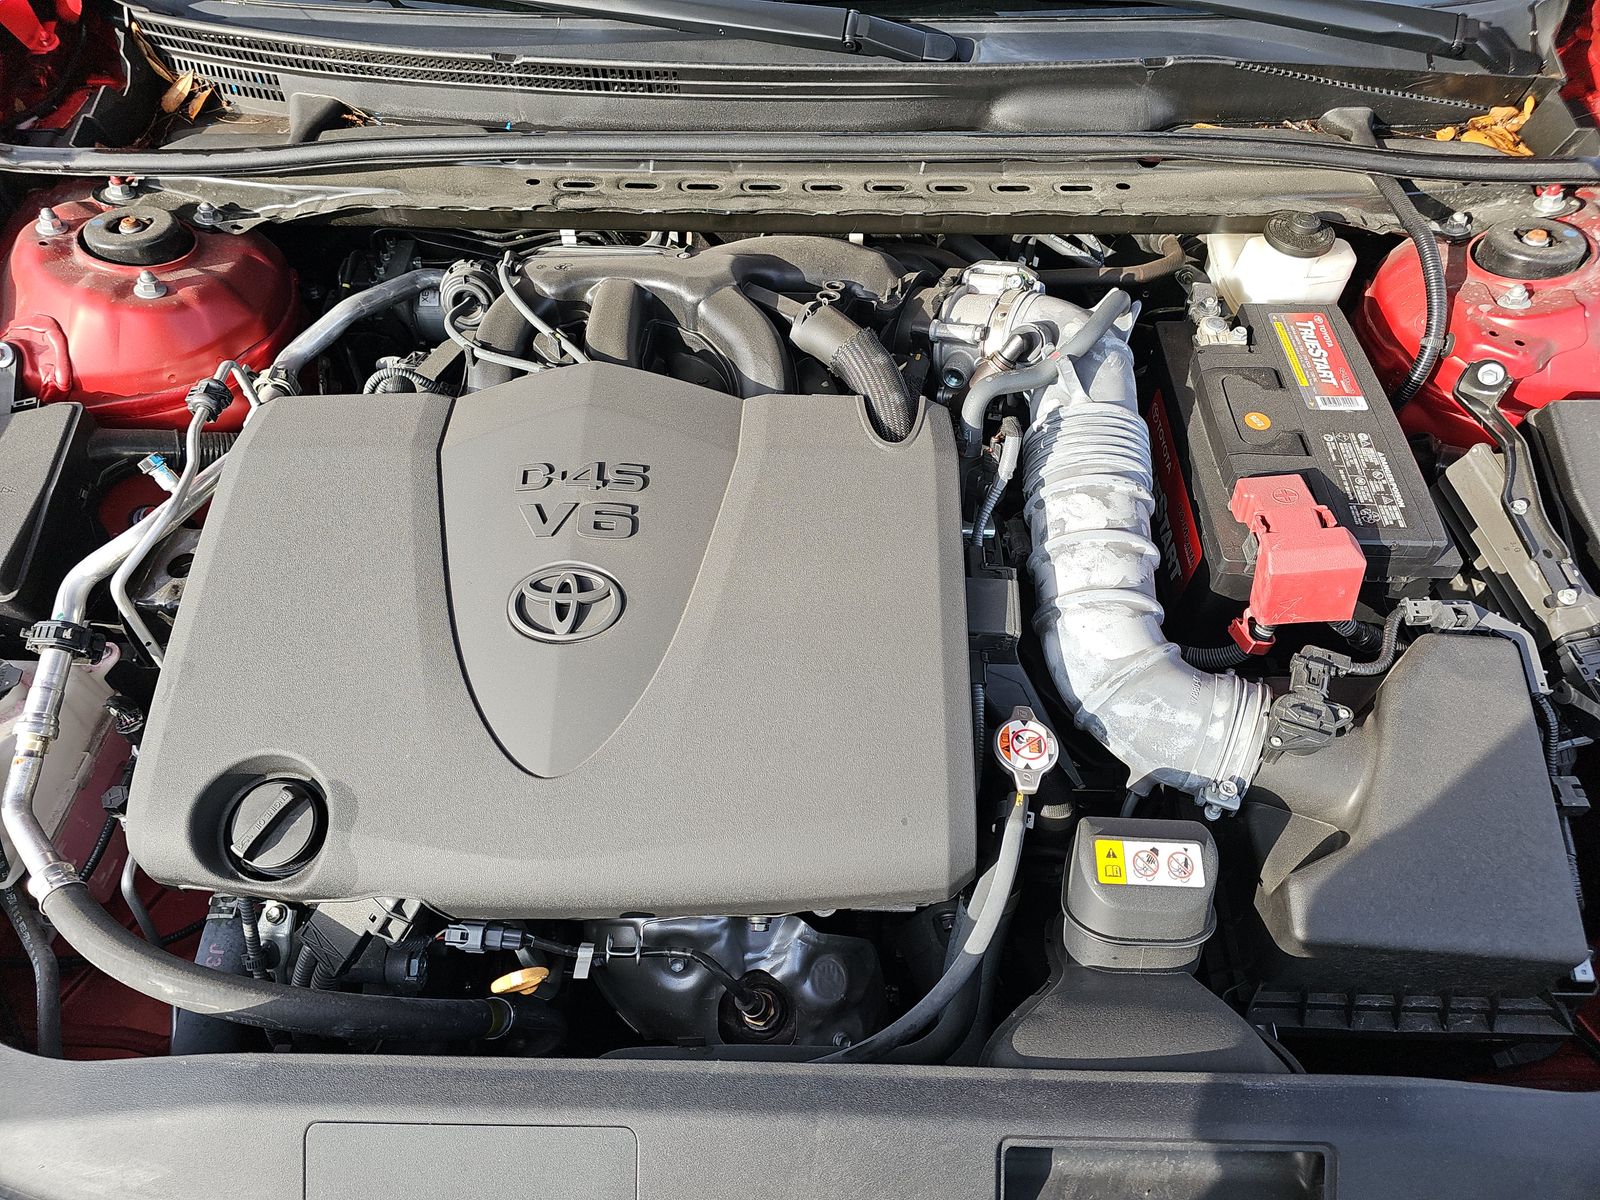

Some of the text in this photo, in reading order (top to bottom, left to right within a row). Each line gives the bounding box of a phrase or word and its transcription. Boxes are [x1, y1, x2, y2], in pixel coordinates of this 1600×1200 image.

[1318, 324, 1335, 348] TOYOTA
[1156, 420, 1172, 475] TOYOTA
[518, 502, 640, 541] V6
[252, 792, 290, 832] ENGINE OIL
